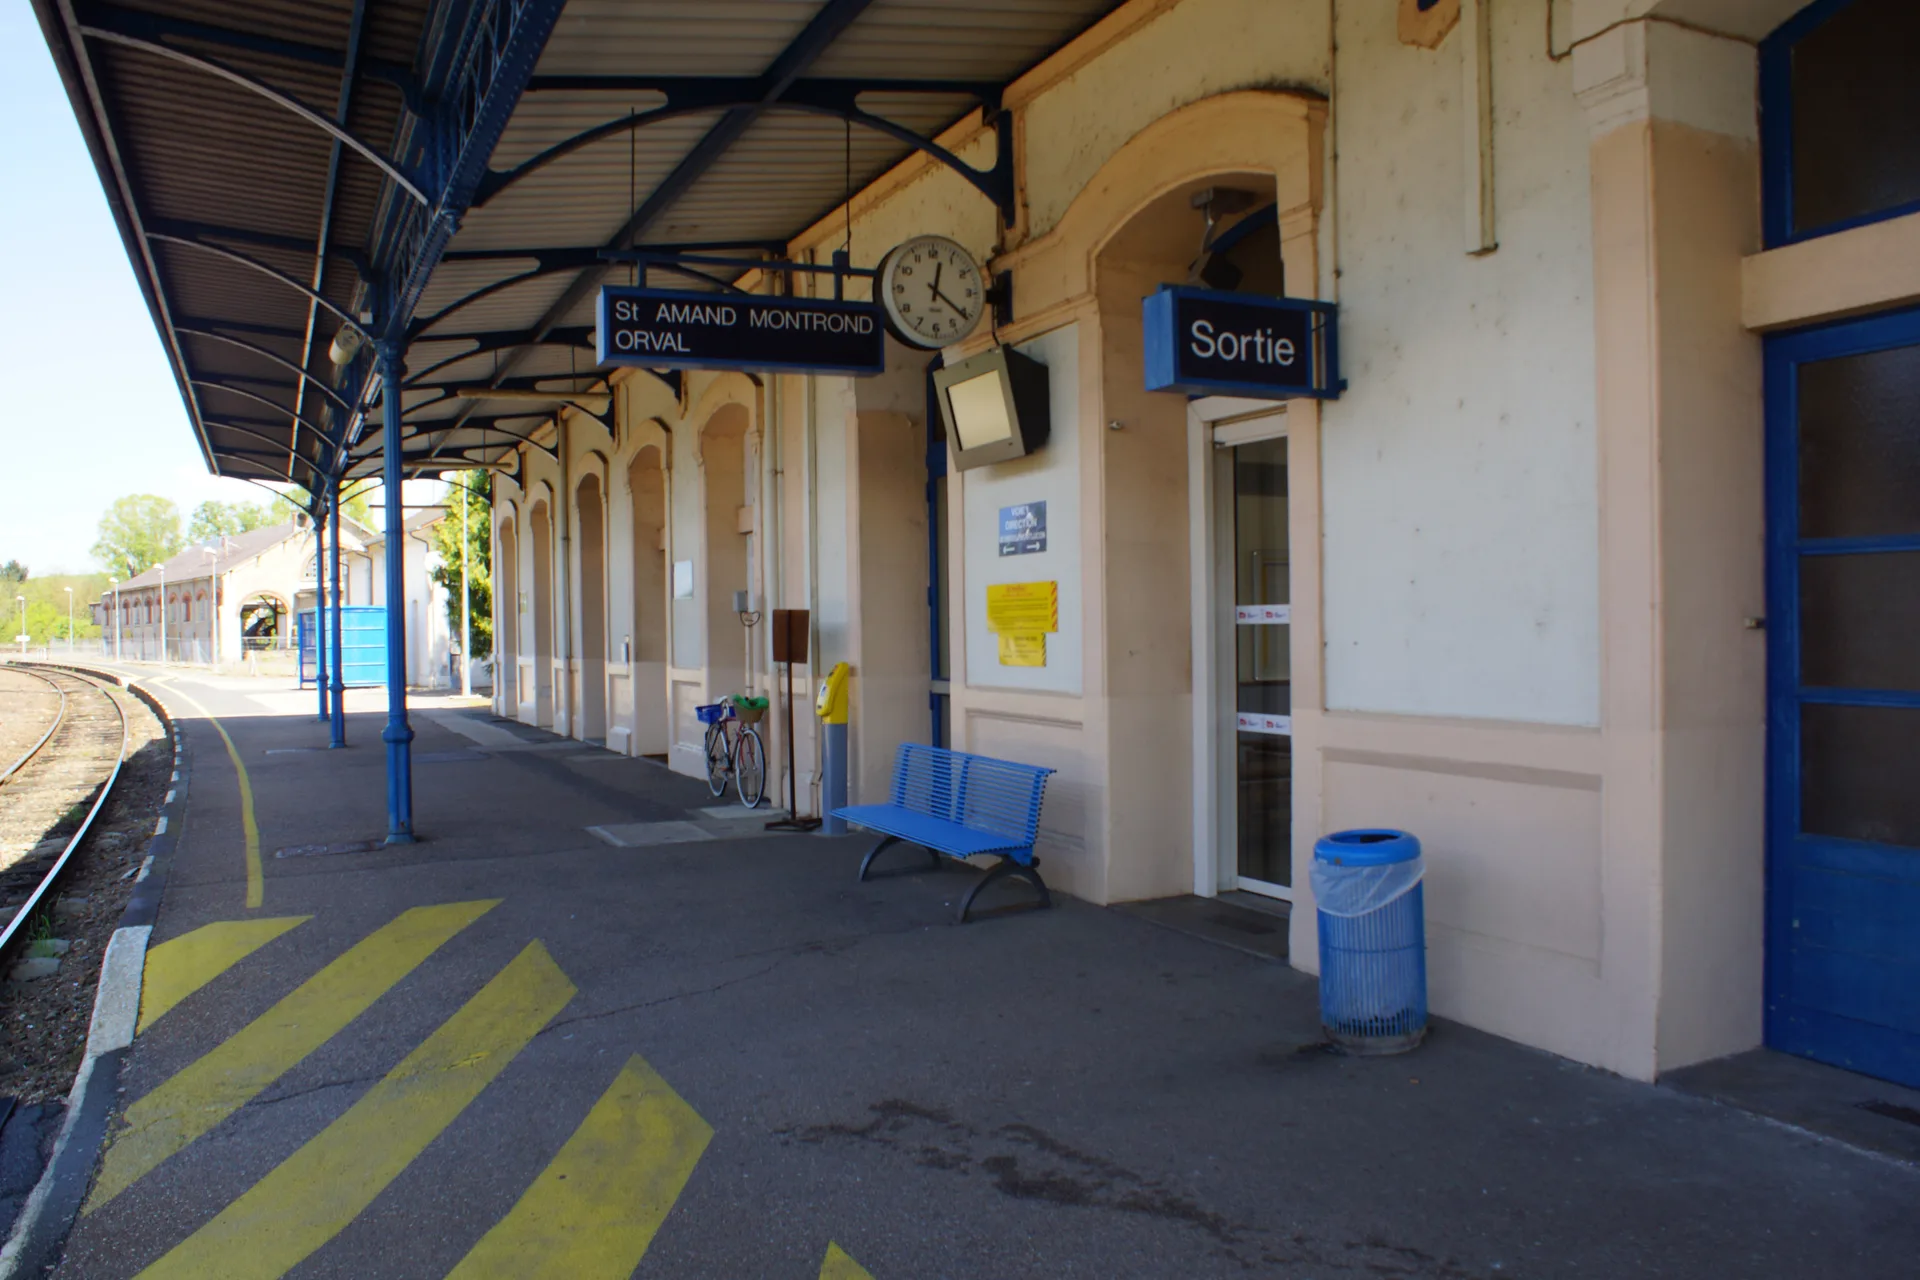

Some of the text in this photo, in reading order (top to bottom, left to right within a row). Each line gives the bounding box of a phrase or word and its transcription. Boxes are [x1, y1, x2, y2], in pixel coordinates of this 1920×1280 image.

[914, 254, 921, 264] 11
[928, 249, 938, 259] 12
[902, 266, 913, 276] 10
[959, 269, 966, 279] 2
[896, 284, 904, 294] 9
[965, 288, 972, 298] 3
[902, 303, 911, 313] 8
[615, 300, 873, 334] St AMAND MONTROND
[917, 316, 924, 326] 7
[932, 323, 940, 332] 6
[949, 318, 956, 328] 5
[615, 330, 691, 352] ORVAL
[1191, 319, 1295, 366] Sortie
